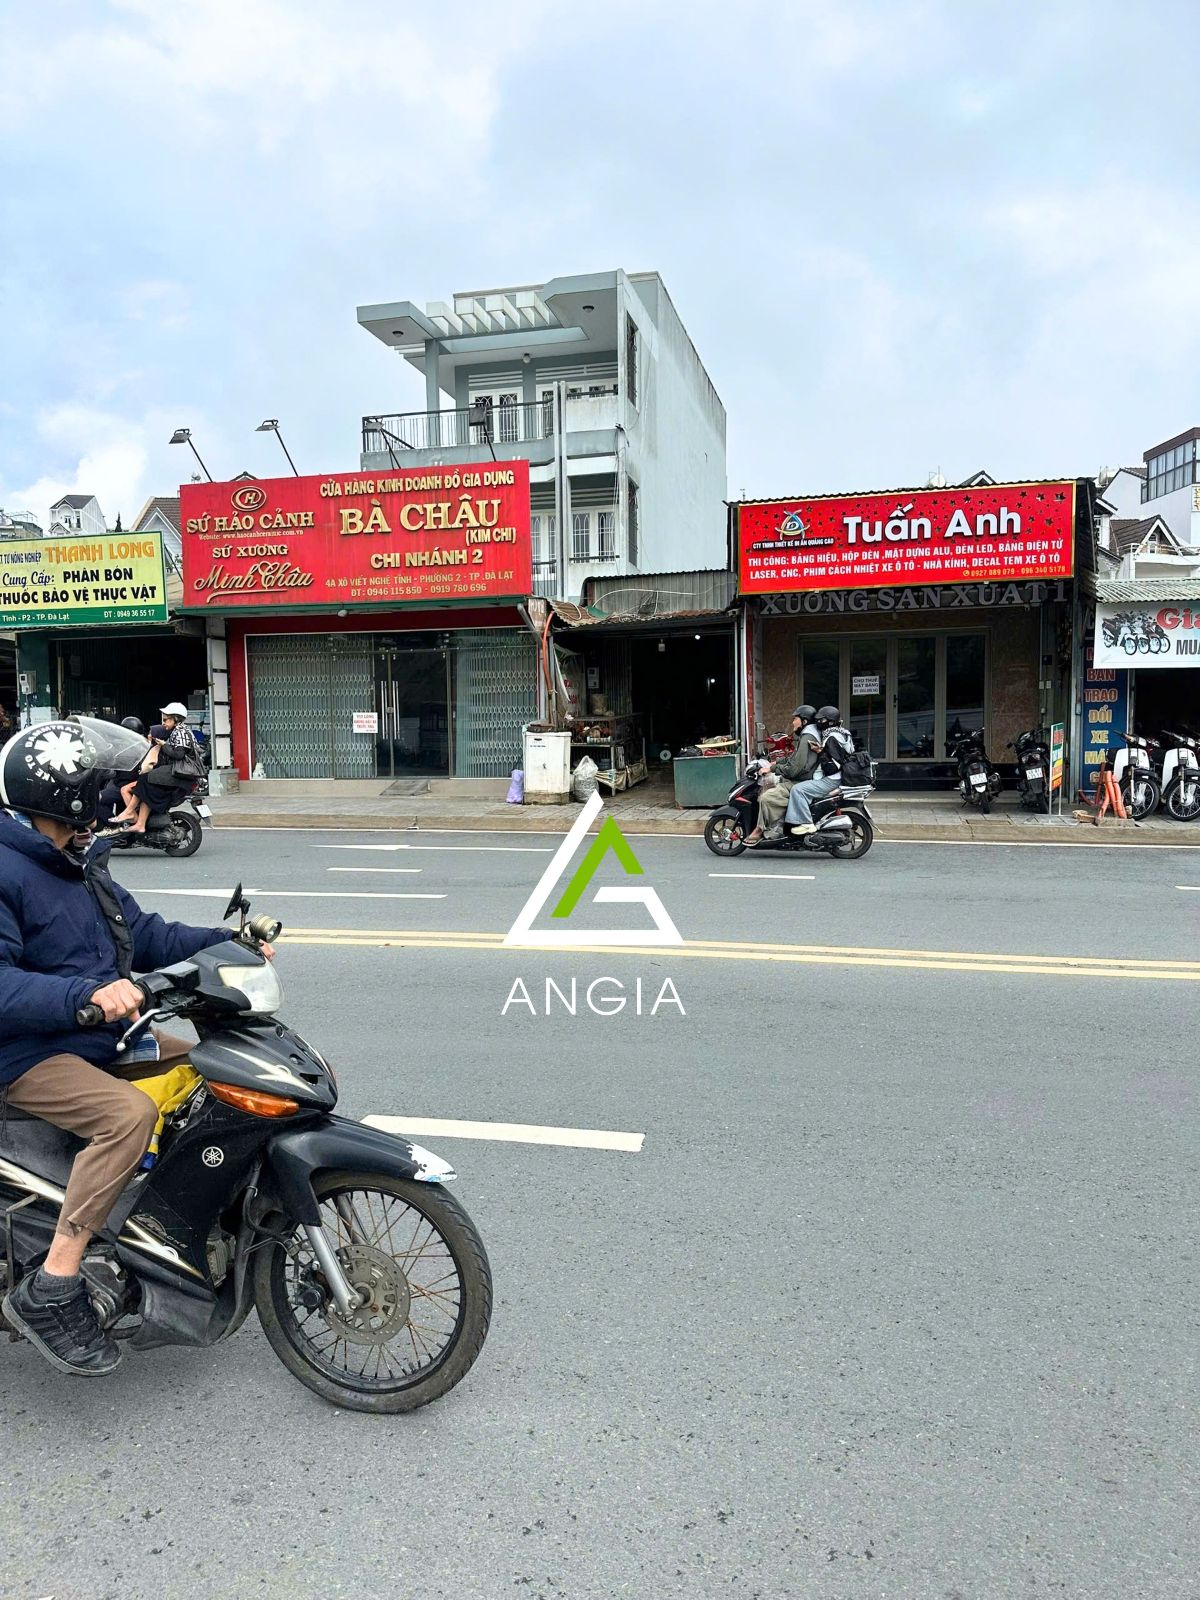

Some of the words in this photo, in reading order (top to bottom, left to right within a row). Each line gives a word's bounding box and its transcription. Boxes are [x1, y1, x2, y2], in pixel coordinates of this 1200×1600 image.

[320, 478, 342, 497] CỬA
[344, 478, 375, 495] HÀNG
[377, 478, 403, 493] KINH
[405, 475, 442, 492] DOANH
[444, 469, 460, 489] ĐỒ
[462, 472, 481, 487] GIA
[483, 470, 515, 488] DỤNG
[186, 512, 211, 533] SỨ
[214, 511, 254, 532] HẢO
[259, 508, 315, 529] CẢNH
[339, 499, 392, 535] BÀ
[400, 493, 501, 531] CHÂU
[843, 503, 932, 544] Tuấn
[944, 506, 1021, 538] Anh
[465, 529, 491, 546] (KIM
[493, 527, 516, 544] CHI)
[45, 544, 102, 564] THANH
[109, 541, 155, 560] LONG
[212, 544, 233, 558] SỨ
[370, 553, 400, 569] CHI
[406, 547, 467, 567] NHÁNH
[471, 549, 484, 565] 2
[748, 558, 761, 567] THI
[791, 552, 814, 564] BẢNG
[842, 549, 859, 562] HỘP
[862, 549, 879, 560] ĐÈN
[906, 547, 931, 559] DỰNG
[955, 543, 973, 555] ĐÈN
[998, 540, 1024, 552] BẢNG
[1026, 540, 1048, 552] ĐIỆN
[1051, 538, 1063, 550] TỬ
[194, 562, 259, 590] Minh
[258, 560, 315, 590] Châu
[803, 566, 826, 577] PHIM
[828, 564, 851, 575] CÁCH
[854, 562, 879, 574] NHIỆT
[882, 562, 893, 572] XE
[895, 560, 901, 571] Ô
[904, 560, 915, 571] TÔ
[923, 559, 943, 570] NHÀ
[972, 556, 1000, 567] DECAL
[1003, 555, 1022, 565] TEM
[1025, 554, 1037, 564] XE
[1039, 552, 1046, 563] Ô
[1049, 552, 1060, 563] TÔ
[2, 572, 27, 588] Cung
[31, 569, 54, 587] Cấp:
[63, 567, 100, 584] PHÂN
[104, 565, 133, 582] BÓN
[455, 573, 461, 581] 2
[73, 586, 89, 605] VỆ
[93, 587, 127, 604] THỰC
[131, 584, 157, 602] VẬT
[367, 587, 389, 596] 0946
[390, 587, 404, 595] 115
[406, 585, 422, 594] 850
[430, 585, 451, 593] 0919
[453, 584, 468, 592] 780
[470, 583, 487, 592] 696
[22, 613, 31, 621] P2
[58, 612, 70, 622] Lạt
[131, 609, 139, 617] 36
[139, 609, 147, 617] 55
[1176, 639, 1200, 655] MU
[1084, 688, 1118, 703] TRAO
[1088, 705, 1112, 724] ĐỔI
[1091, 730, 1109, 744] XE
